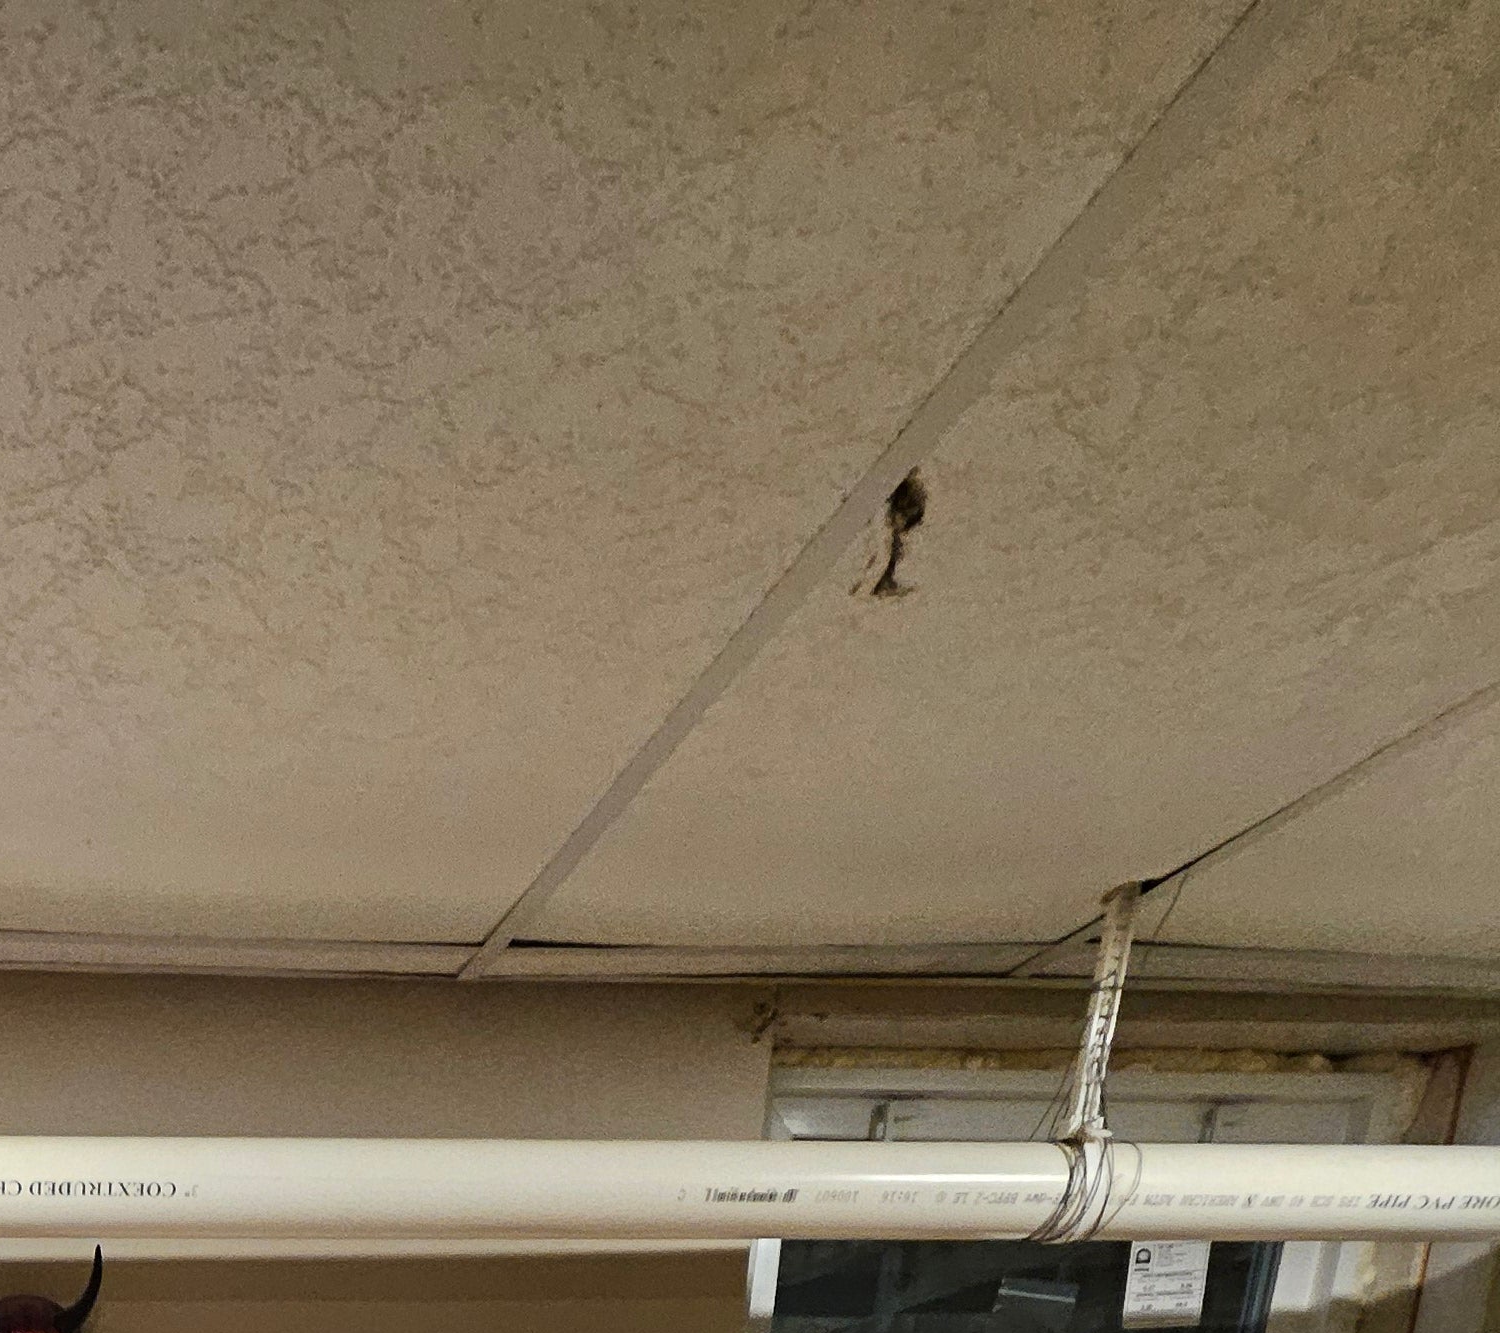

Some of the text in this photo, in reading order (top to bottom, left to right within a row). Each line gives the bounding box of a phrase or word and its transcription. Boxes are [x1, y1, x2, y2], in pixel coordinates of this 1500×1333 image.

[29, 1180, 177, 1198] COEXTRUDED
[1366, 1192, 1413, 1209] PIPE
[1414, 1194, 1456, 1210] PVC
[1457, 1194, 1500, 1210] ORE
